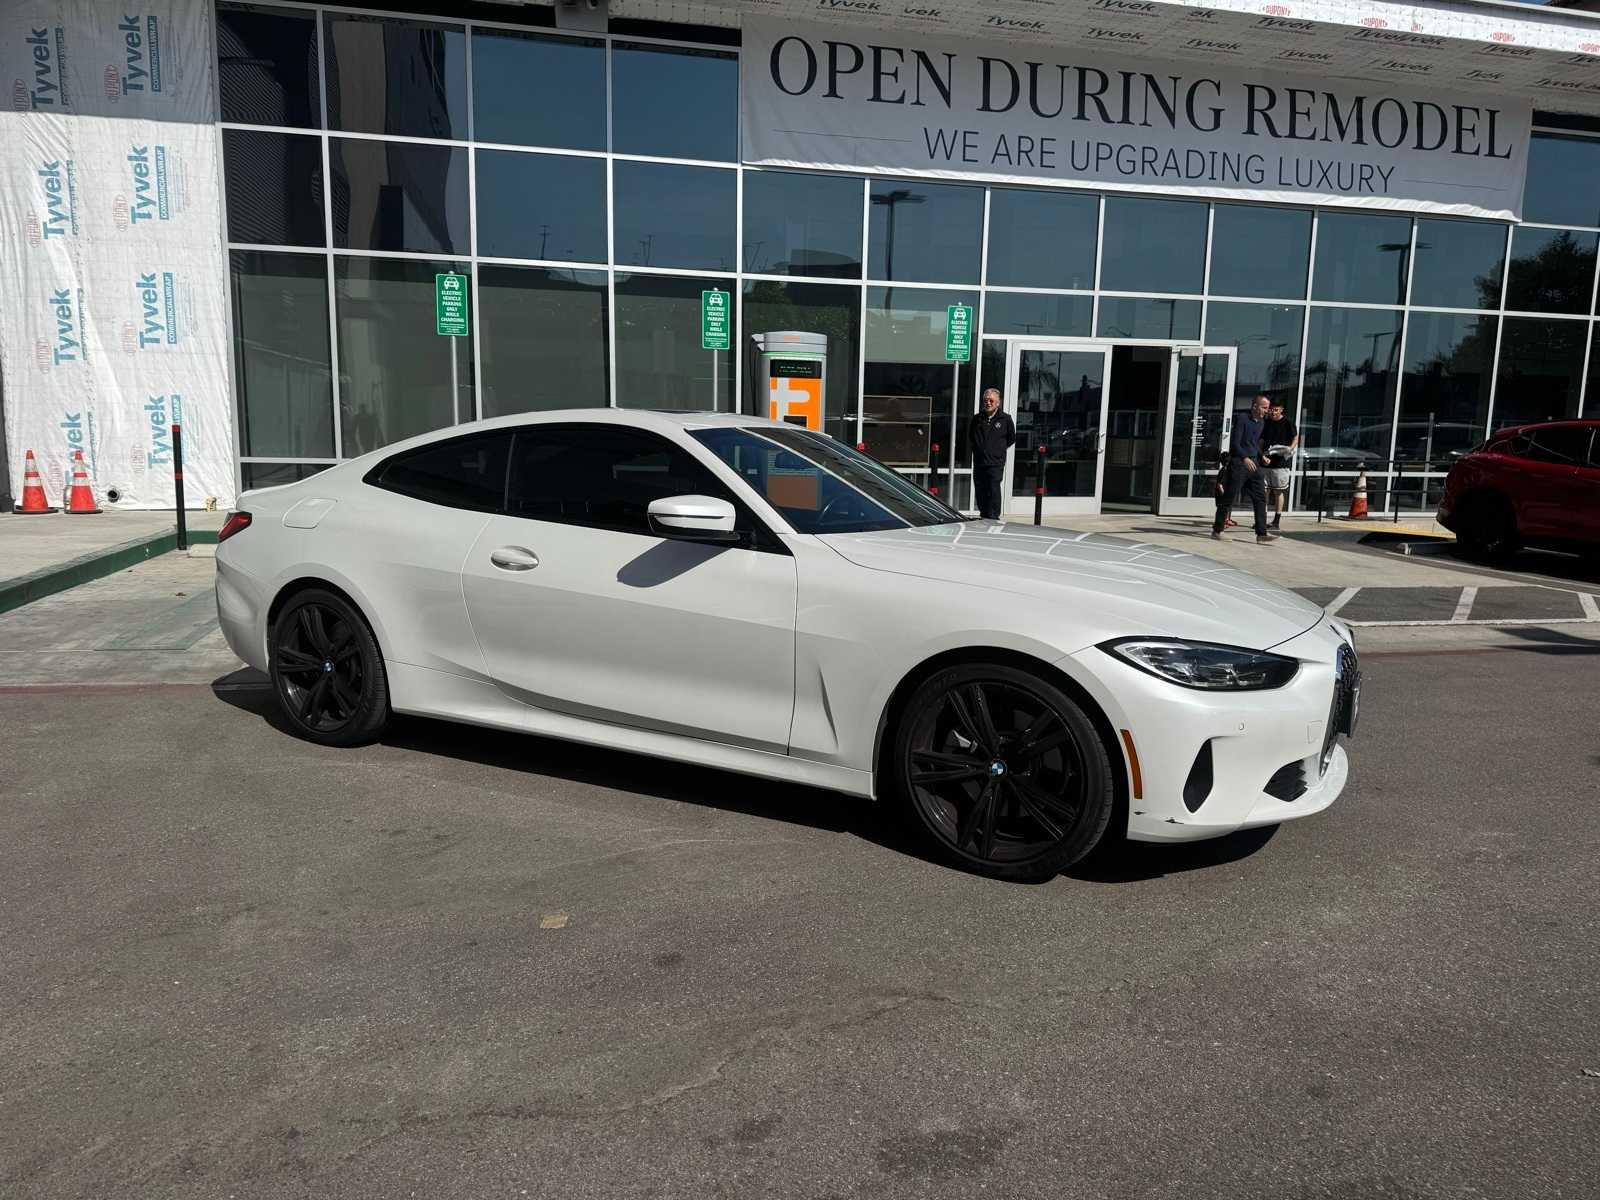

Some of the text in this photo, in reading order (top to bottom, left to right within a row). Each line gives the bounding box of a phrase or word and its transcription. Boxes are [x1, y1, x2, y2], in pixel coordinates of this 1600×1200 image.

[117, 15, 149, 96] Tyvek
[986, 15, 1046, 29] Tyvek
[1087, 27, 1145, 40] Tyvek
[1186, 39, 1244, 50] Tyvek
[1257, 16, 1316, 30] Tyvek
[26, 27, 58, 109] Tyvek
[770, 36, 1514, 160] OPEN DURING REMODEL
[127, 143, 157, 225] Tyvek
[923, 127, 1396, 194] WE ARE UPGRADING LUXURY
[38, 159, 70, 240] Tyvek
[48, 288, 81, 366] Tyvek
[136, 272, 165, 349] Tyvek
[144, 394, 174, 470] Tyvek
